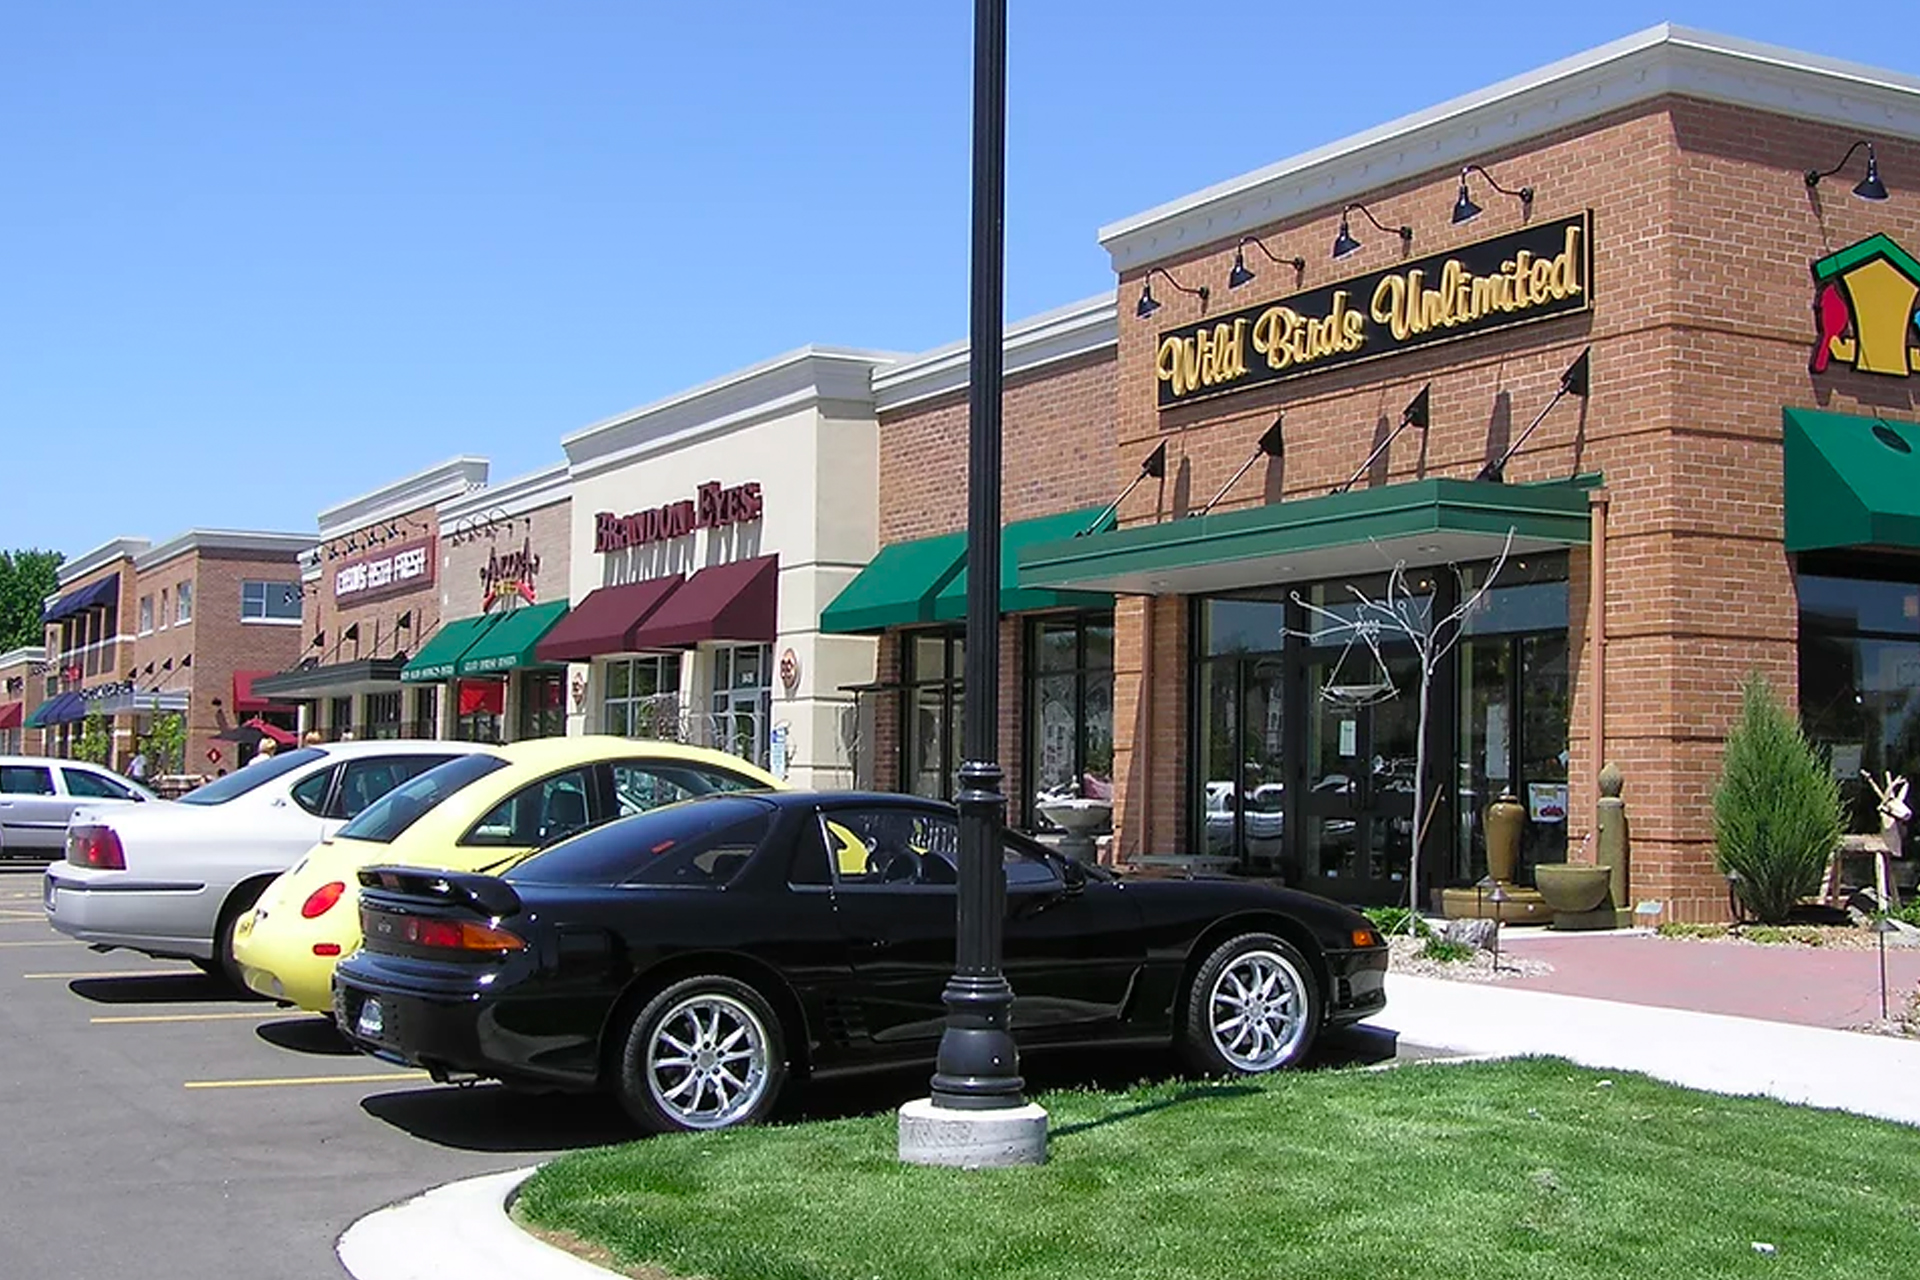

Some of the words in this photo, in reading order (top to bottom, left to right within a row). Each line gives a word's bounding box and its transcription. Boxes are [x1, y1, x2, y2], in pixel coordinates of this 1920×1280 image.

[1157, 318, 1247, 396] Wild
[1253, 290, 1365, 369] Birds
[1371, 226, 1581, 340] Unlimited
[594, 500, 696, 553] BRANDON
[697, 480, 763, 529] EYES
